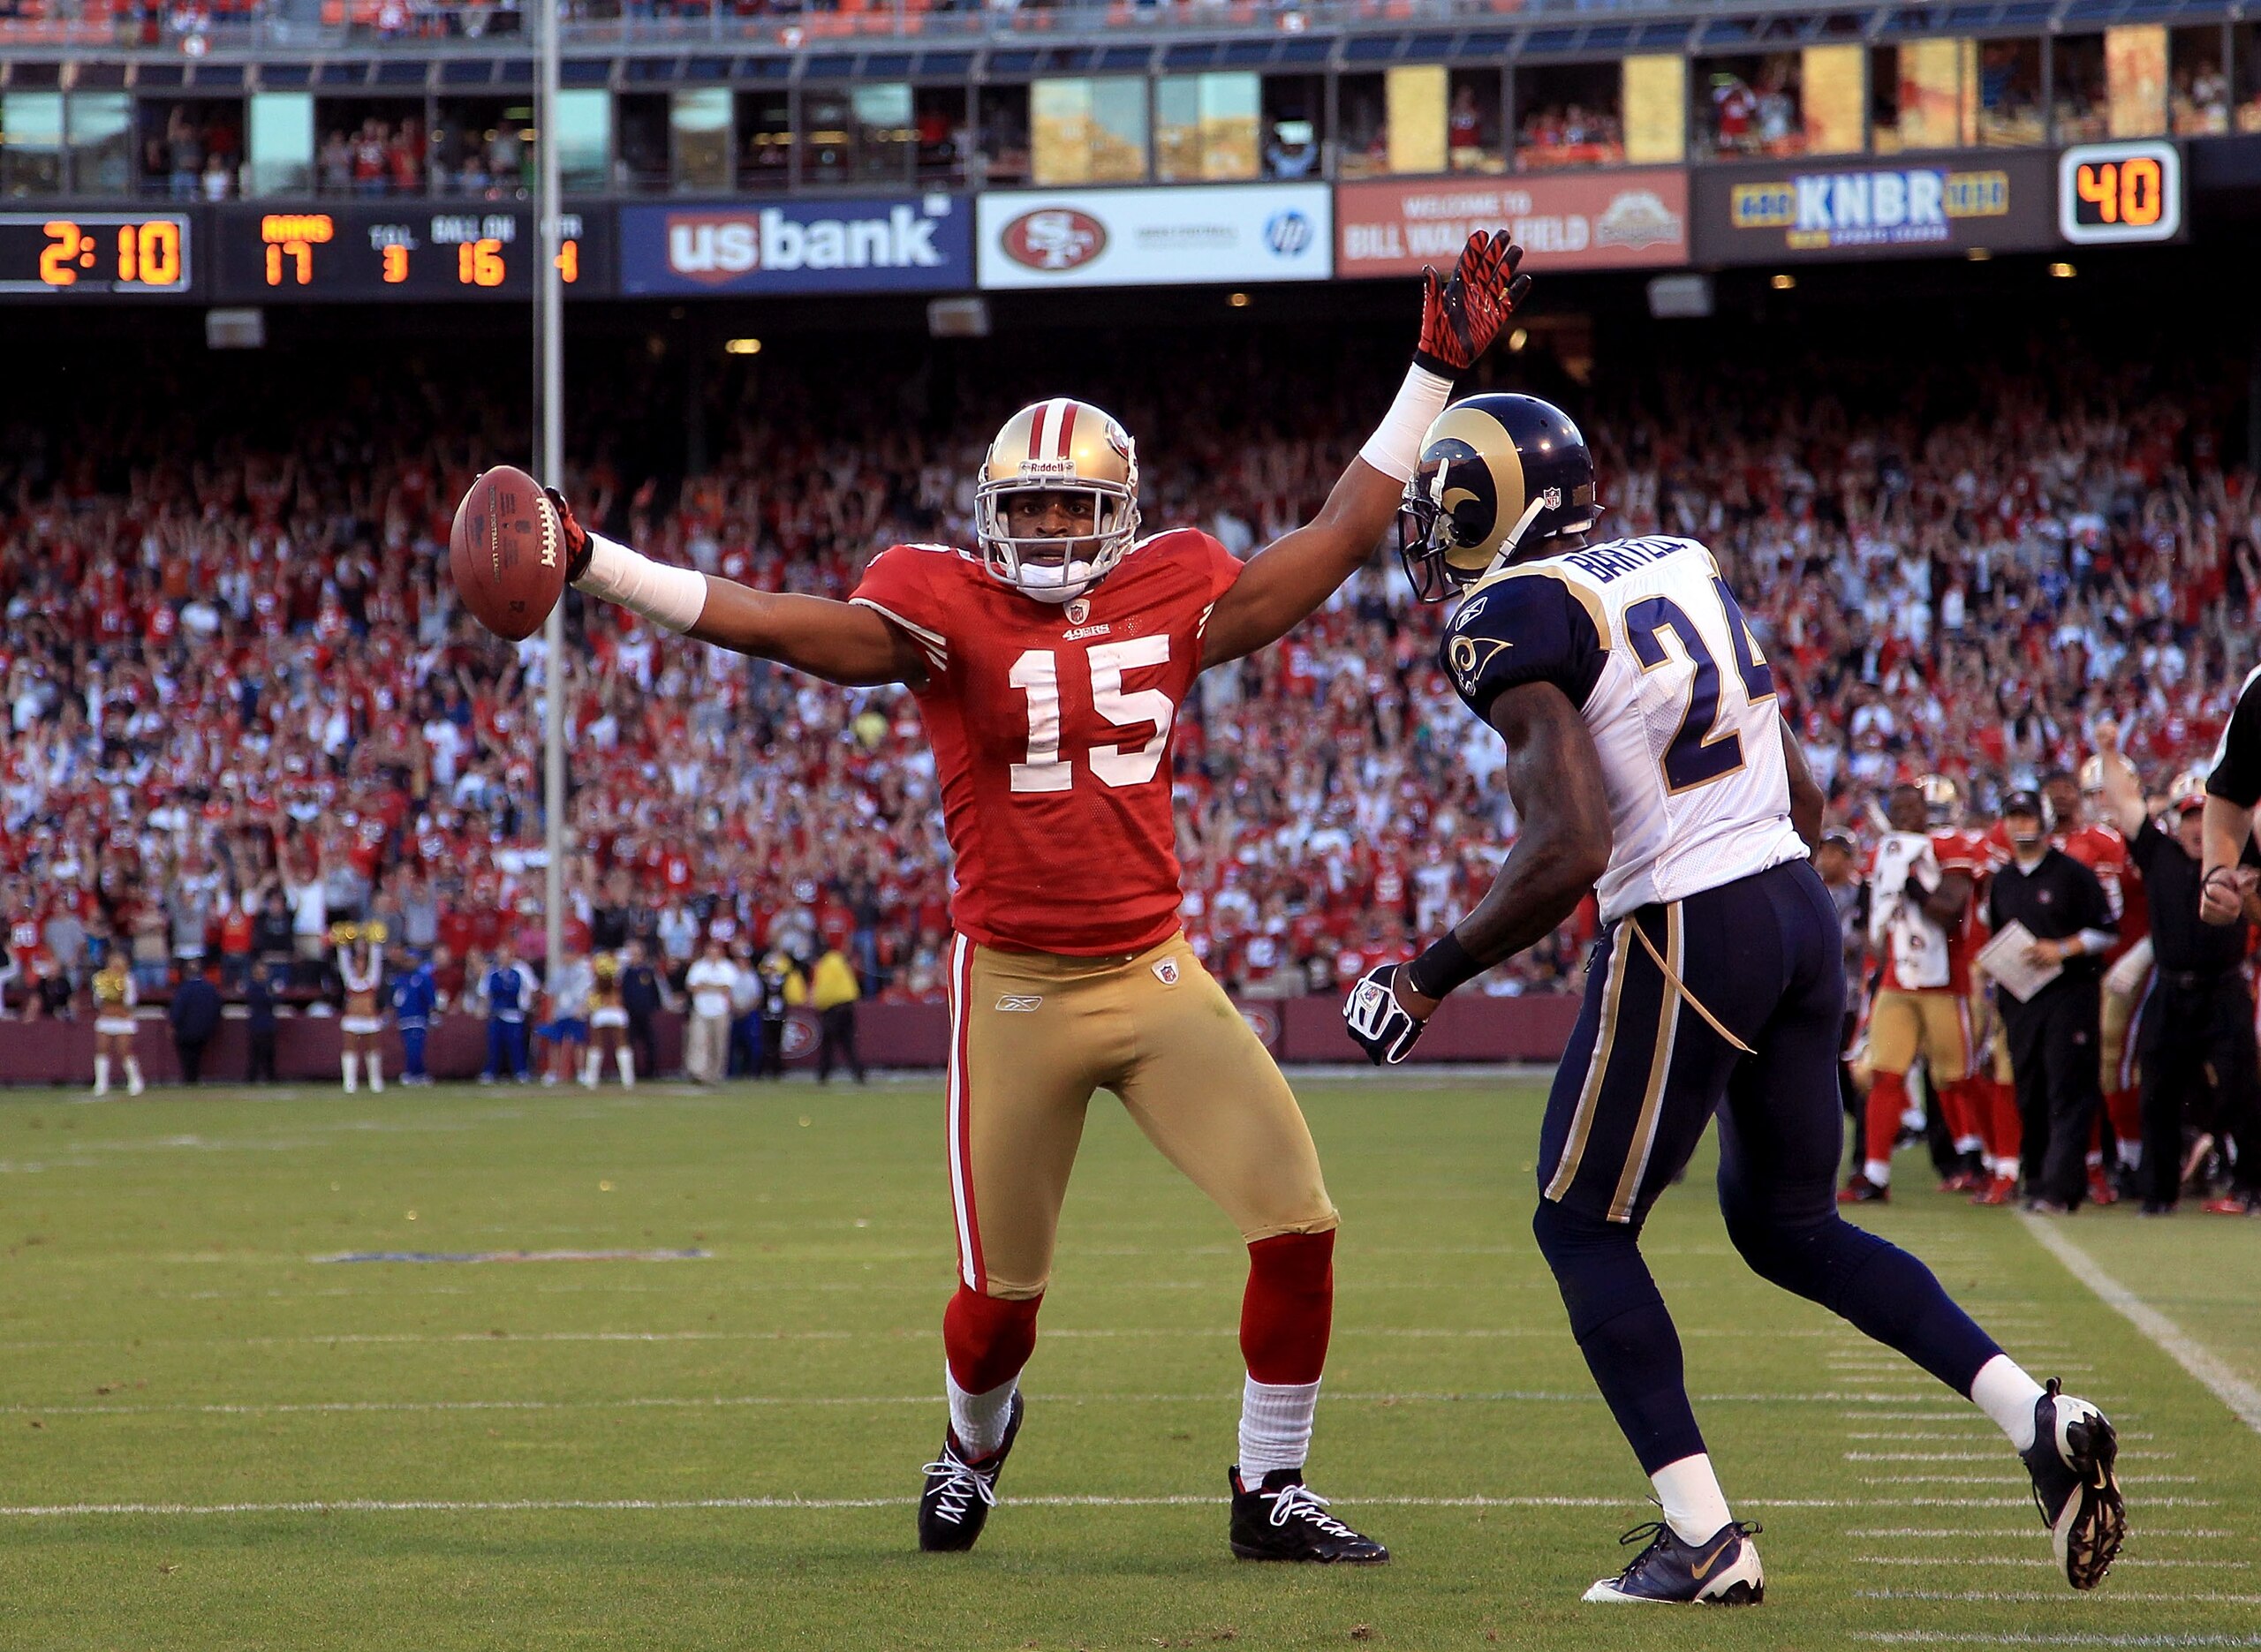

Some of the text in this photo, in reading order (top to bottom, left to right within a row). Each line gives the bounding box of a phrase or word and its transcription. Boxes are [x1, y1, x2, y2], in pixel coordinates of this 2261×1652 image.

[1402, 189, 1532, 219] WELCOME TO
[1795, 169, 1942, 230] KNBR
[2077, 159, 2160, 225] 40
[40, 221, 179, 285] 2:10
[669, 204, 941, 273] usbank
[1343, 223, 1406, 260] BILL
[1511, 214, 1589, 253] FIELD
[266, 241, 312, 286] 17
[382, 244, 409, 283] 3
[459, 238, 505, 287] 16
[1032, 463, 1063, 472] Riddell
[490, 513, 499, 551] FOOTBALL
[1062, 623, 1111, 641] 49ERS
[1621, 573, 1778, 796] 24
[1010, 634, 1175, 793] 15
